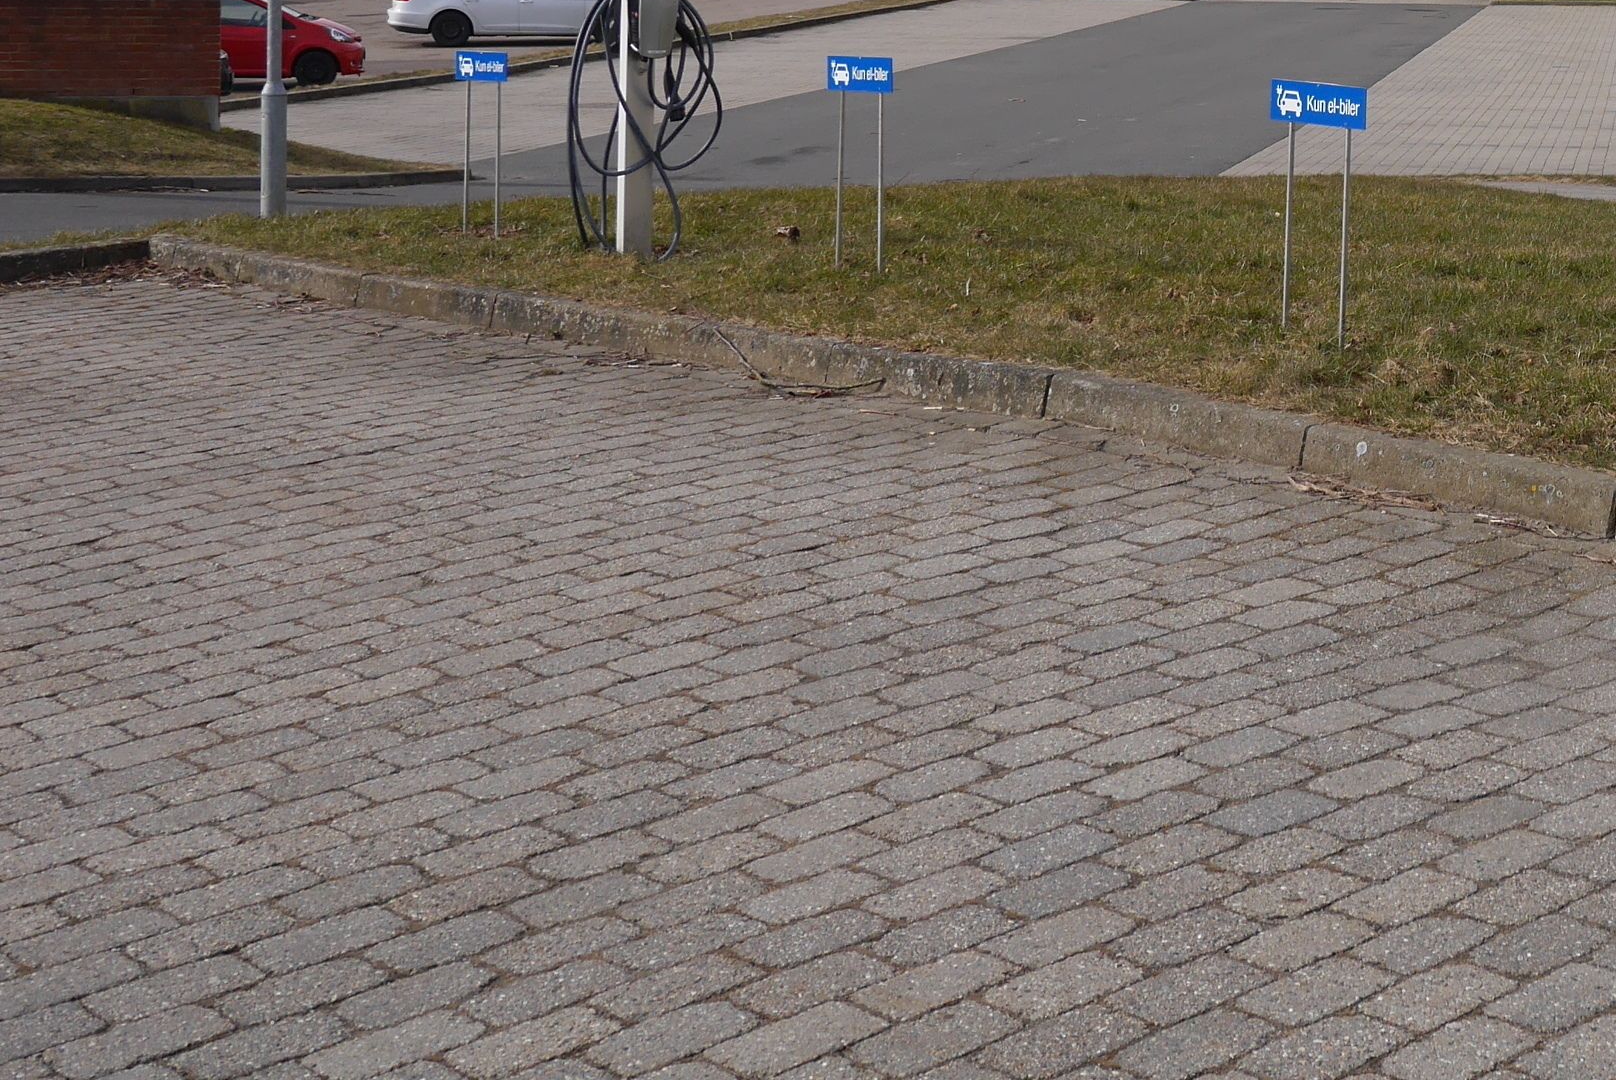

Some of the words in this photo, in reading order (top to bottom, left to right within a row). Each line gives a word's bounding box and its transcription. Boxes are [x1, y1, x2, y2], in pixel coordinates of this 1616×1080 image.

[852, 66, 866, 80] Kun
[866, 67, 888, 81] el-biler
[1306, 95, 1326, 113] Kun
[1327, 98, 1360, 117] el-biler
